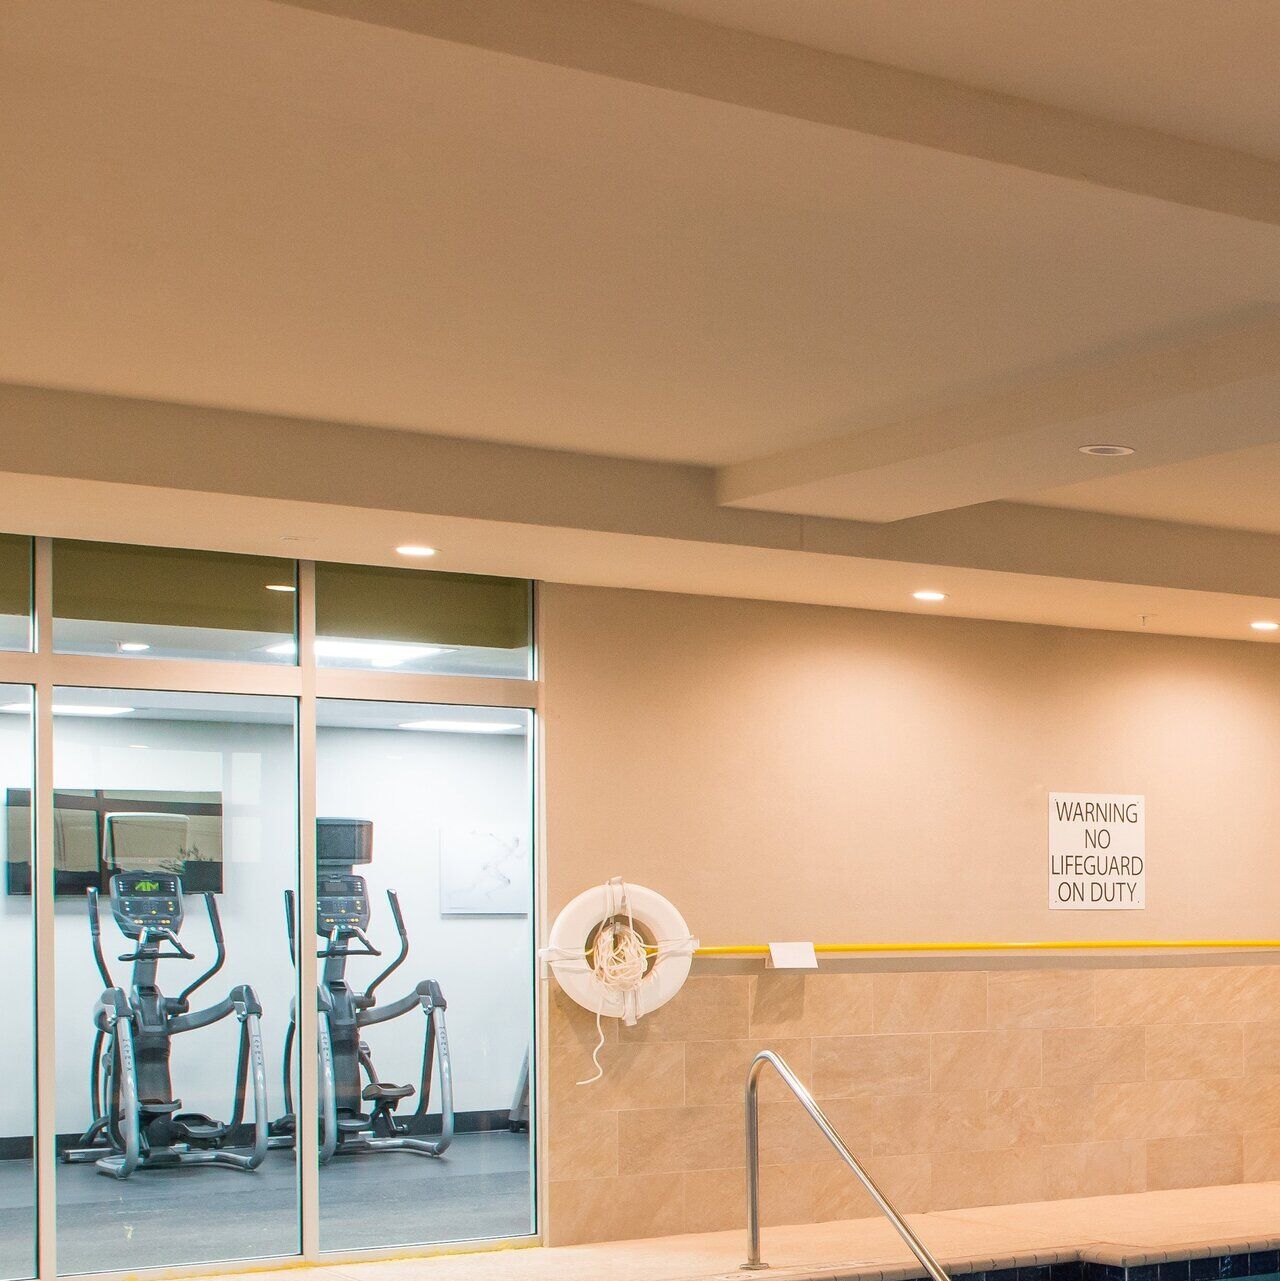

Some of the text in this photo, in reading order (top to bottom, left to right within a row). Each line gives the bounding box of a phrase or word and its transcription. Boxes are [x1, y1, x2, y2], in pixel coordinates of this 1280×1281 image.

[1056, 801, 1138, 823] WARNING
[1085, 828, 1111, 849] NO
[1051, 855, 1144, 876] LIFEGUARD
[1058, 881, 1137, 902] ON DUTY
